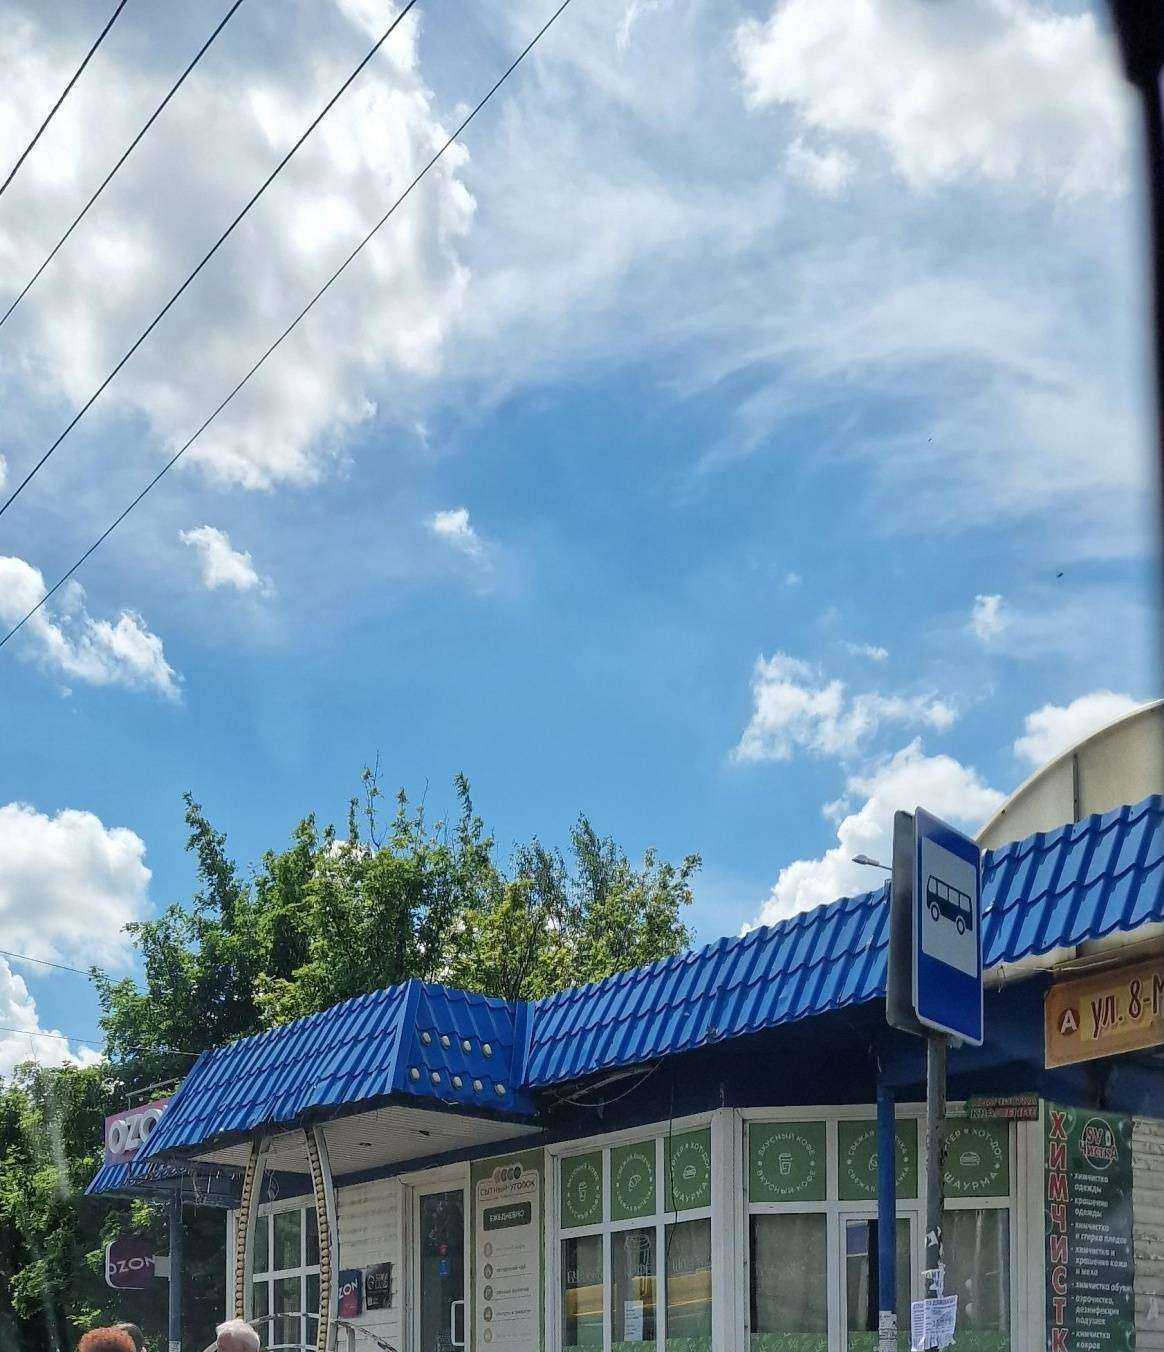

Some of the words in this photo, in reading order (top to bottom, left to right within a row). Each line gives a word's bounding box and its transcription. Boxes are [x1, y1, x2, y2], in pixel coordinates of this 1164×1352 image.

[1091, 995, 1124, 1040] ул.
[108, 1104, 168, 1154] OZO
[758, 1132, 795, 1157] ВКУСНЫЙ
[944, 1172, 1001, 1192] ШАУРМА
[1074, 1173, 1109, 1183] химчистка
